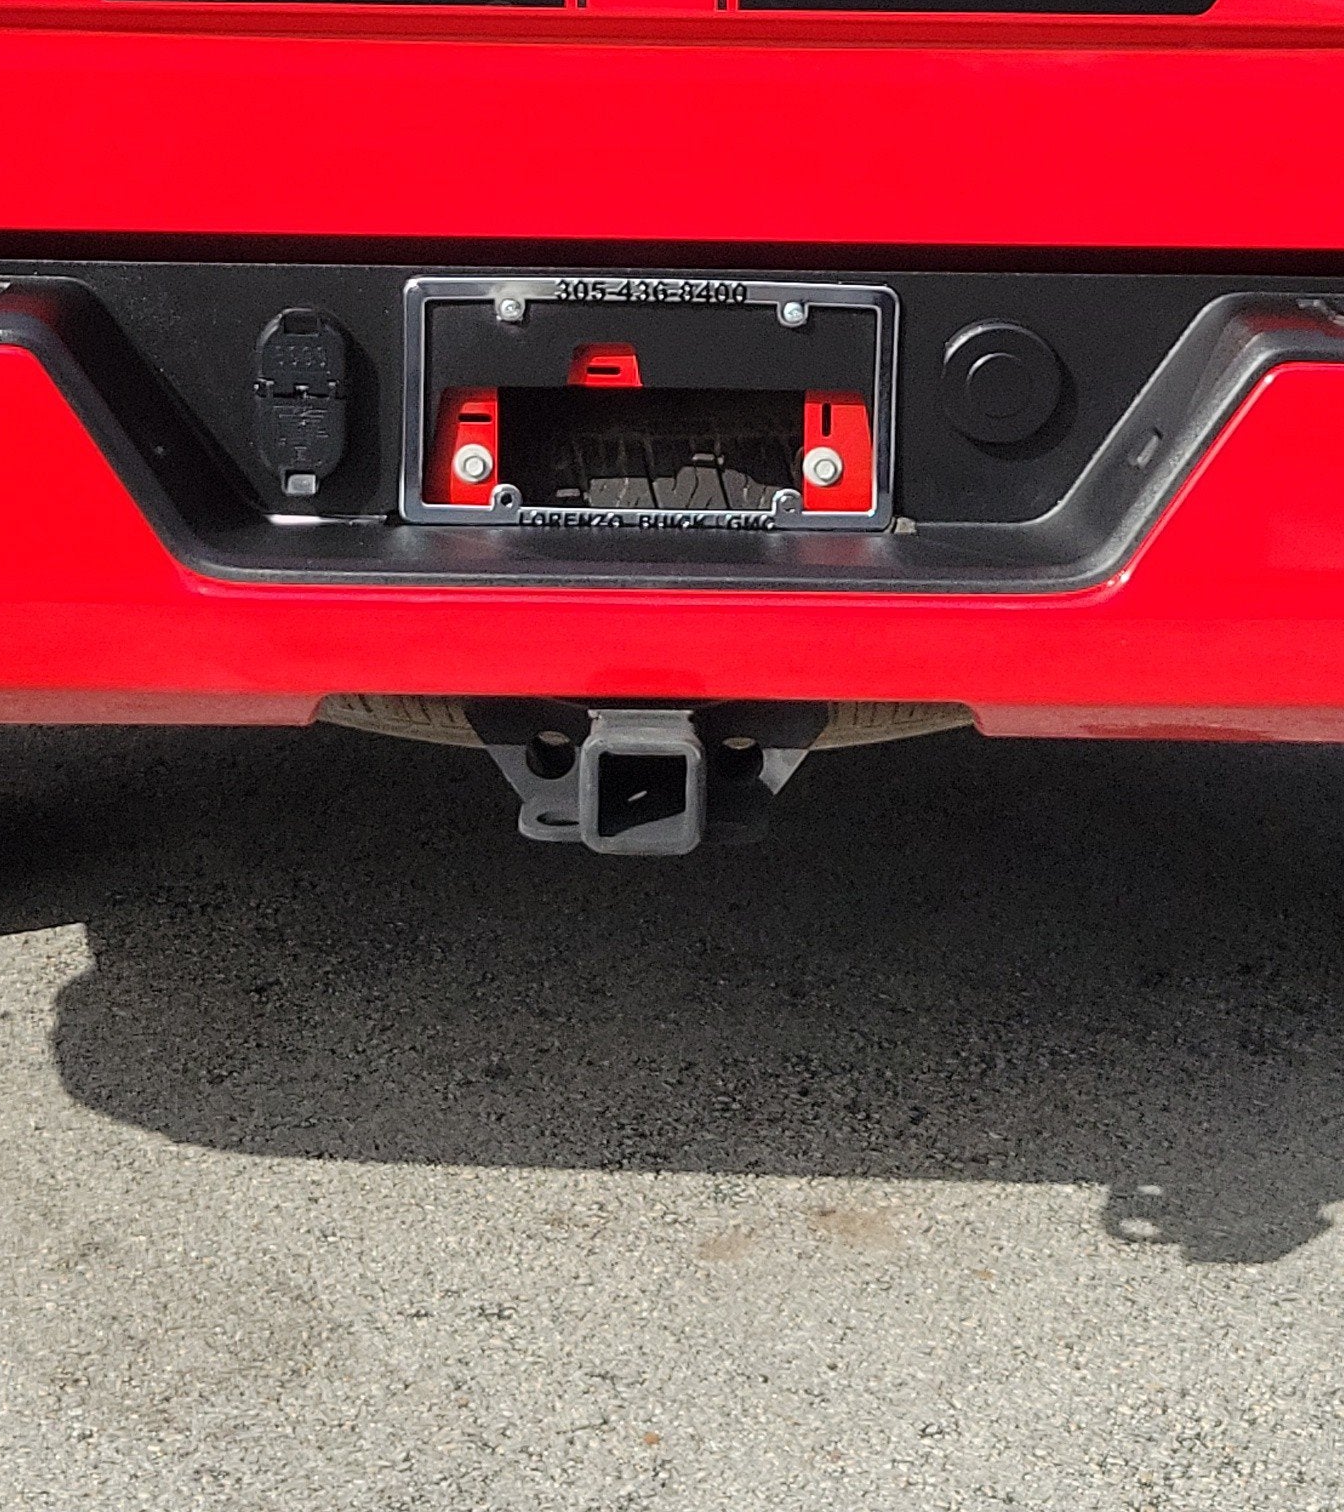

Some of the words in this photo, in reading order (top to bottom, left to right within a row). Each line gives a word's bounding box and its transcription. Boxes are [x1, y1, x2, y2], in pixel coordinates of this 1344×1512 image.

[557, 279, 748, 304] 305-436-8400
[519, 511, 624, 528] LORENZO
[639, 514, 707, 530] BUICK
[726, 516, 775, 531] GMC
